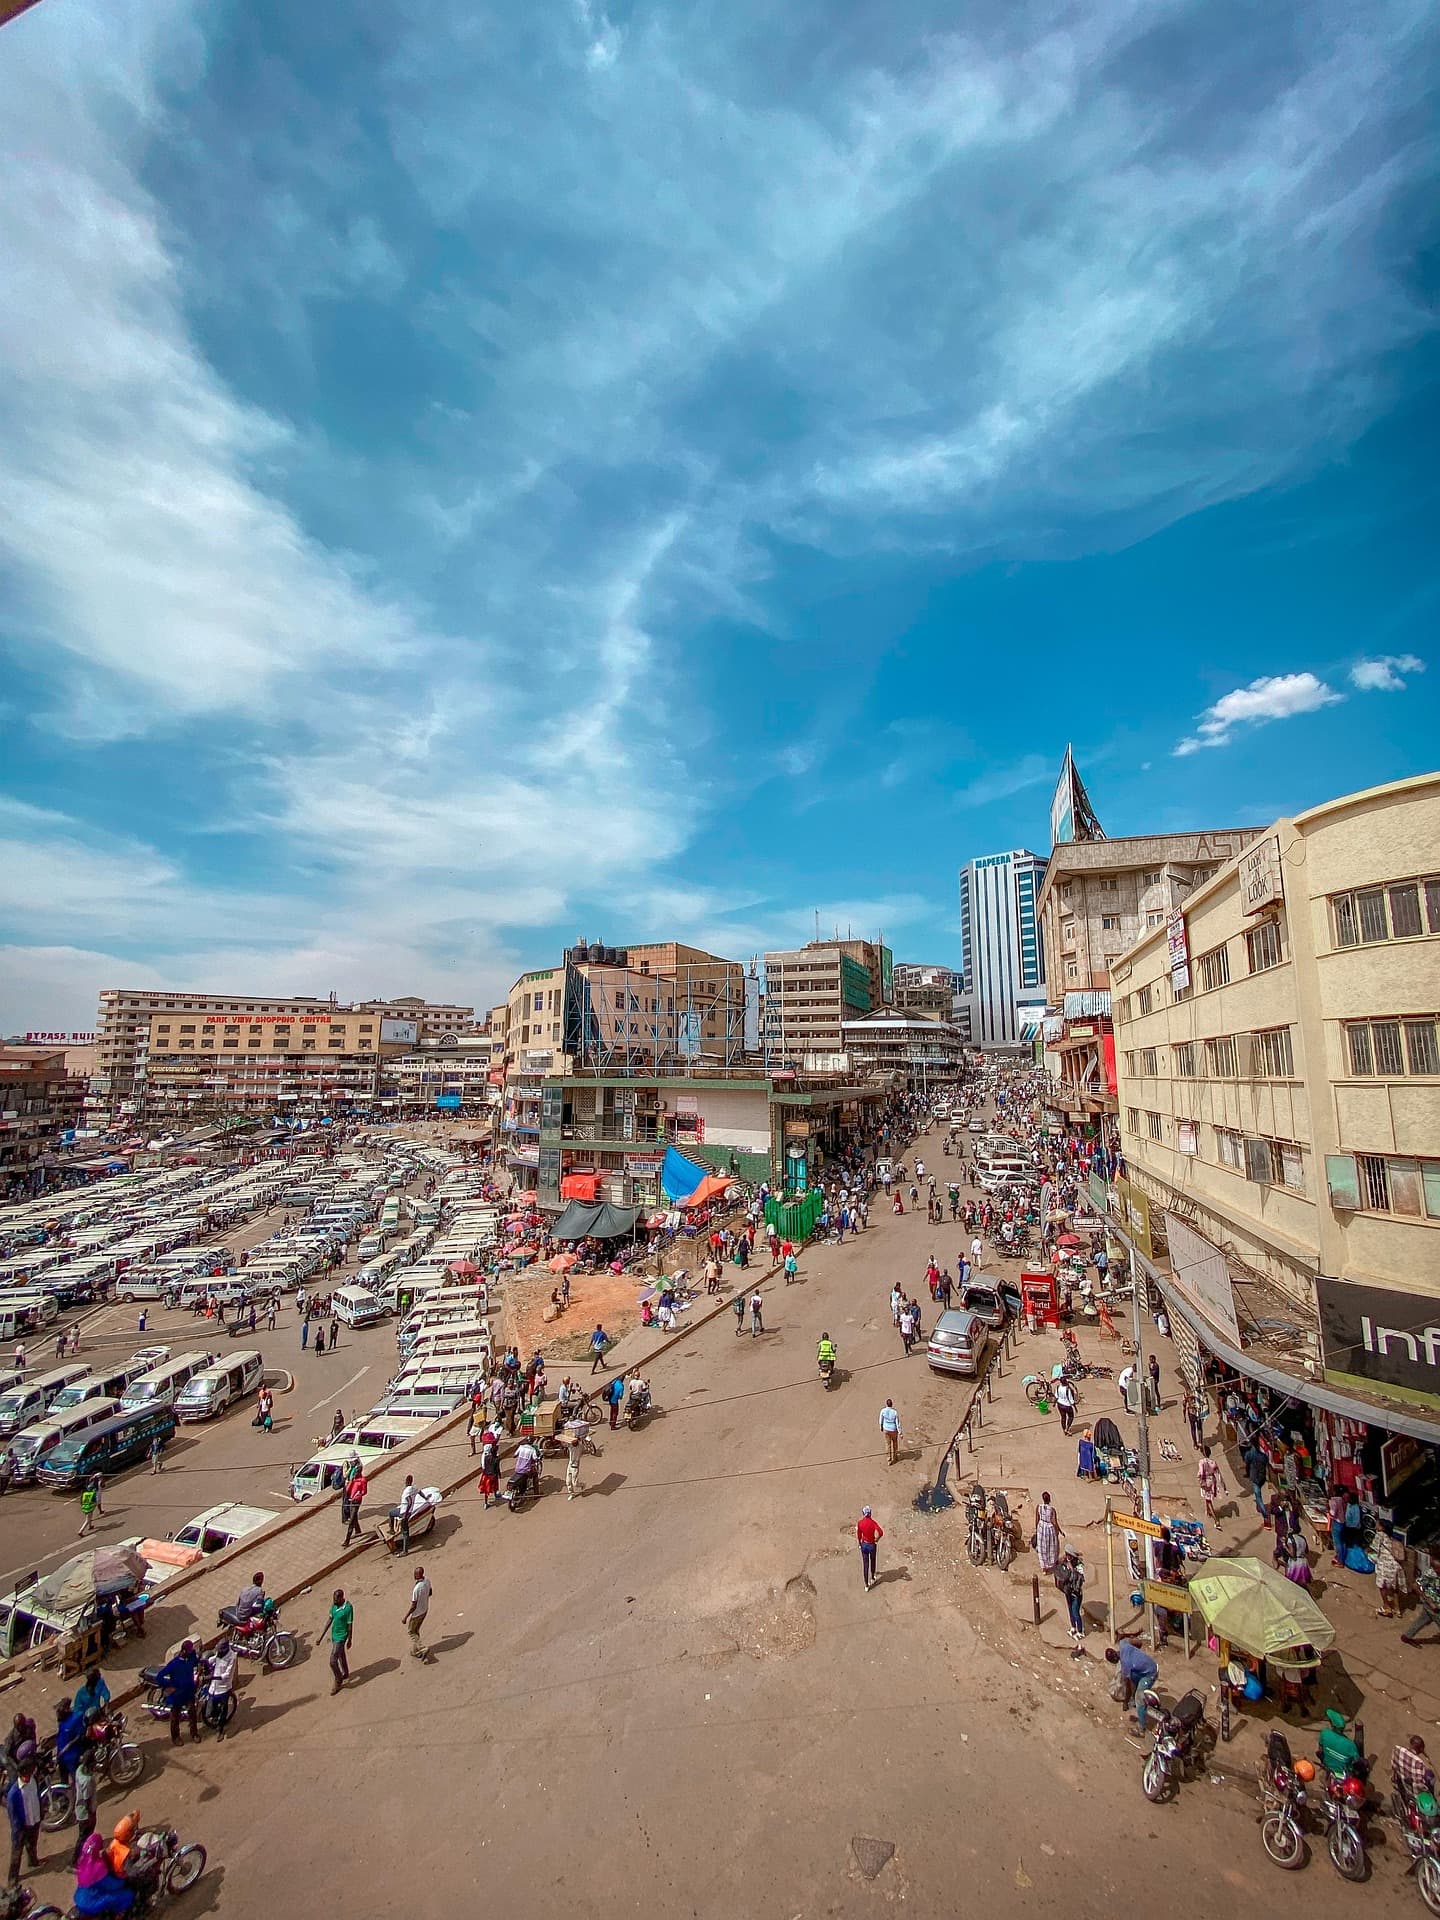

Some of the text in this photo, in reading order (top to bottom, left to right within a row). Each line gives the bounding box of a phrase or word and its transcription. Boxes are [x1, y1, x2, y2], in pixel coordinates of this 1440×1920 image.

[1247, 876, 1268, 903] LOOK
[206, 1016, 332, 1024] PARK VIEW SHOPPING CENTRE
[26, 1032, 67, 1040] BYPASS
[1113, 1515, 1156, 1532] Market Street
